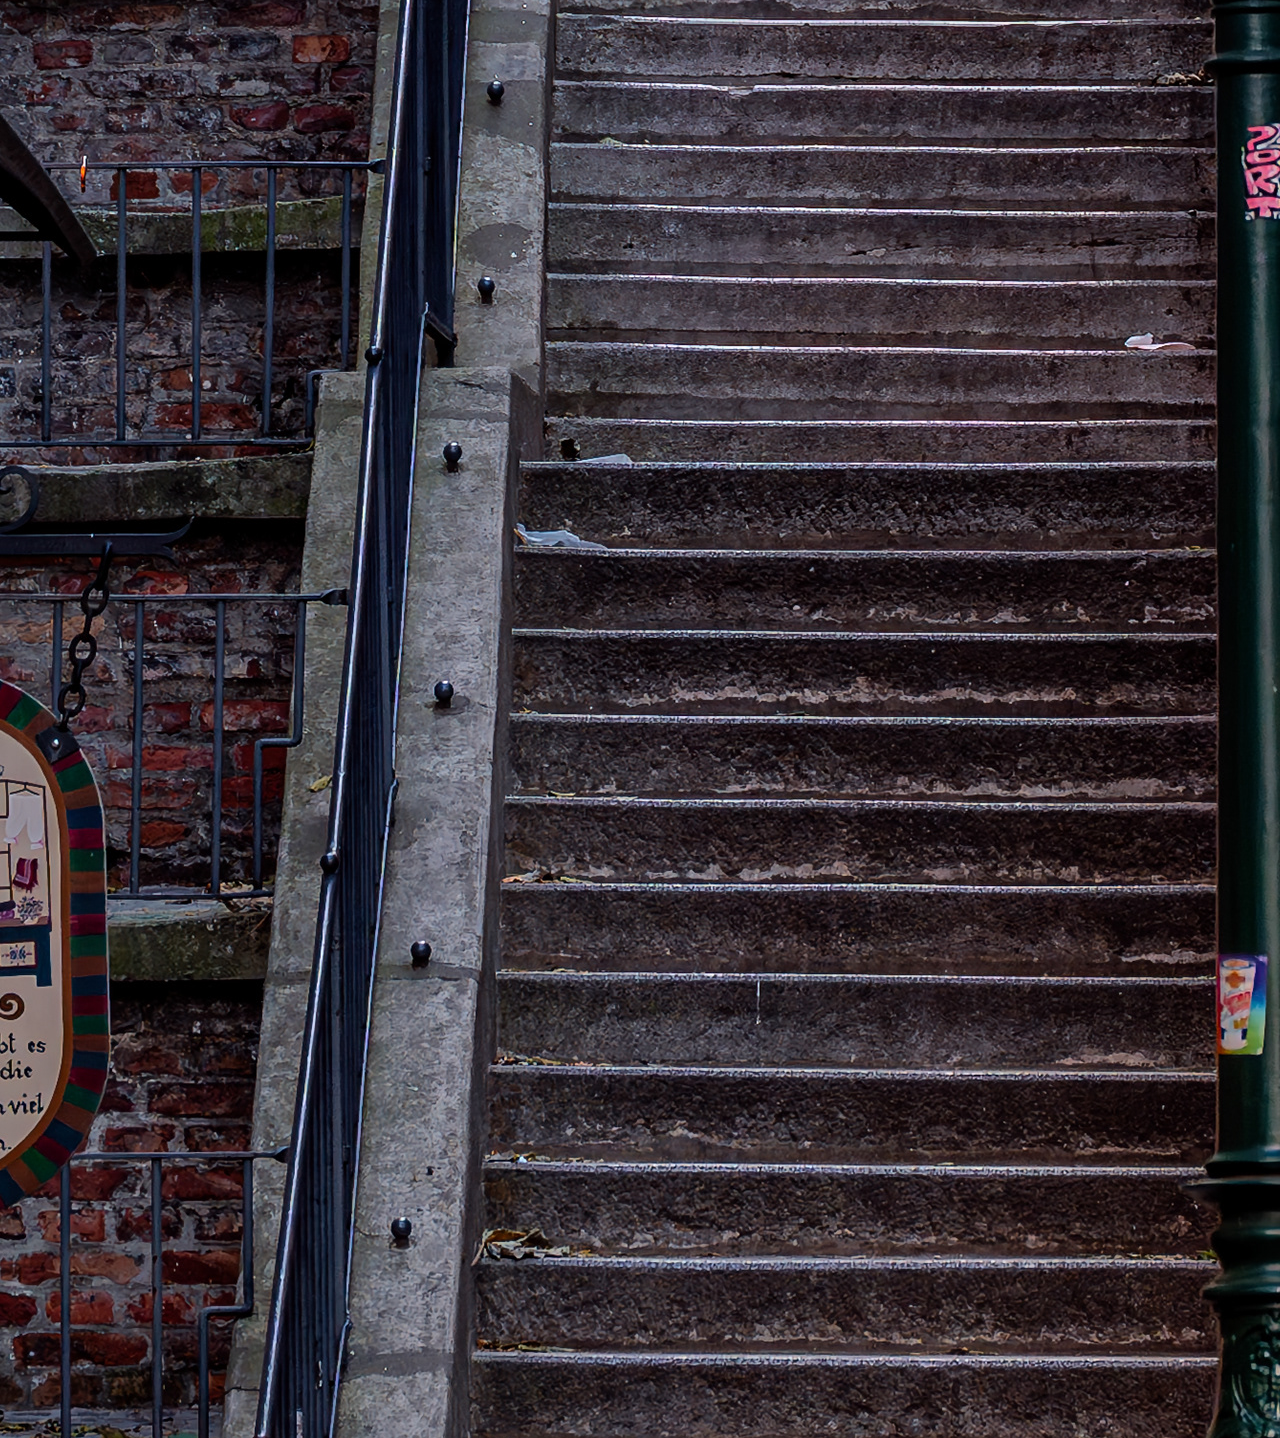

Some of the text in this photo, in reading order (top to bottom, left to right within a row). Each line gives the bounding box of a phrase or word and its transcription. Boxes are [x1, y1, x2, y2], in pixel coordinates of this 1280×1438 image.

[27, 1039, 47, 1054] es
[0, 1059, 33, 1080] die
[7, 1092, 44, 1115] viel
